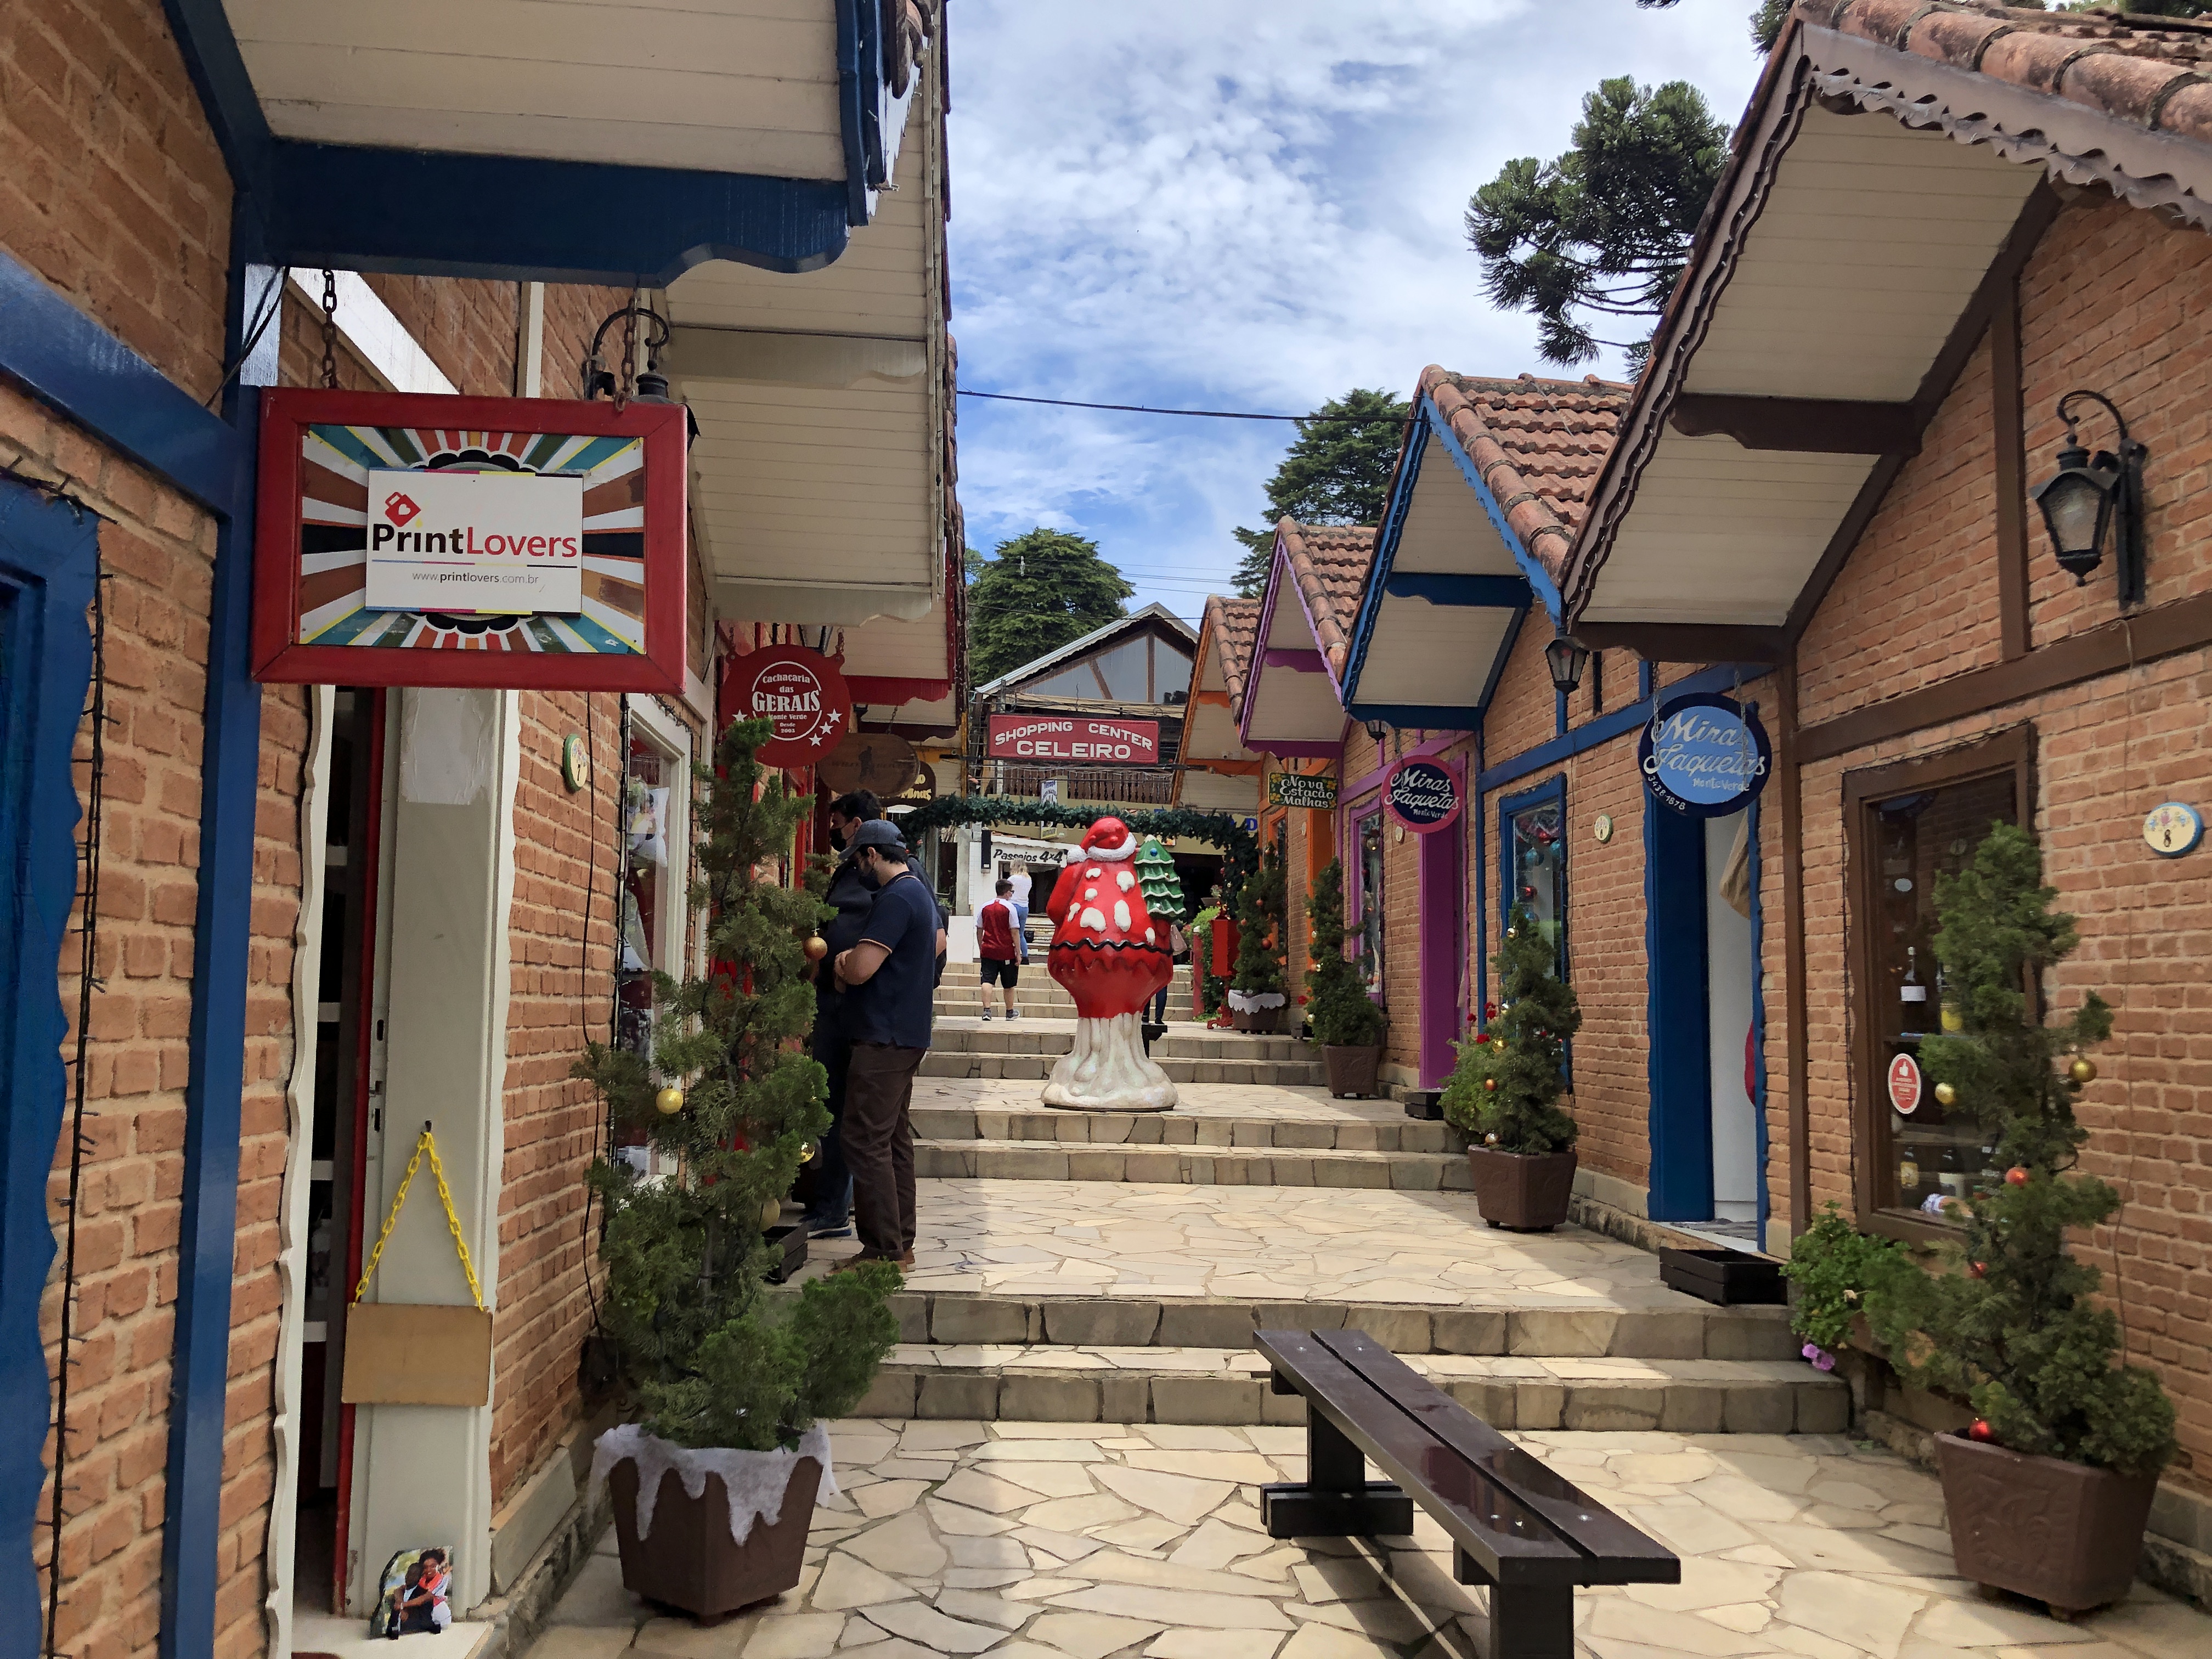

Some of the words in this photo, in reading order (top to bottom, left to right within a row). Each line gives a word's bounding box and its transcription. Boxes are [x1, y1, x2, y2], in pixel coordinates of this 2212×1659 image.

[372, 523, 577, 558] PrintLovers
[412, 572, 539, 584] www.printlovers.com.br
[752, 690, 820, 712] GERAIS
[995, 721, 1073, 746] SHOPPING
[1088, 723, 1153, 752] CENTER
[1651, 712, 1749, 747] Minas
[1016, 740, 1131, 759] CELEIRO
[1643, 742, 1766, 777] Jaquetas
[1285, 775, 1324, 789] Nova
[1390, 768, 1451, 792] Minas
[1692, 776, 1720, 789] Monte
[1282, 795, 1328, 809] Malhas
[1384, 786, 1459, 810] Jaquetas
[1431, 810, 1448, 819] Verde
[2163, 829, 2171, 848] 8
[1039, 850, 1064, 864] 4x4
